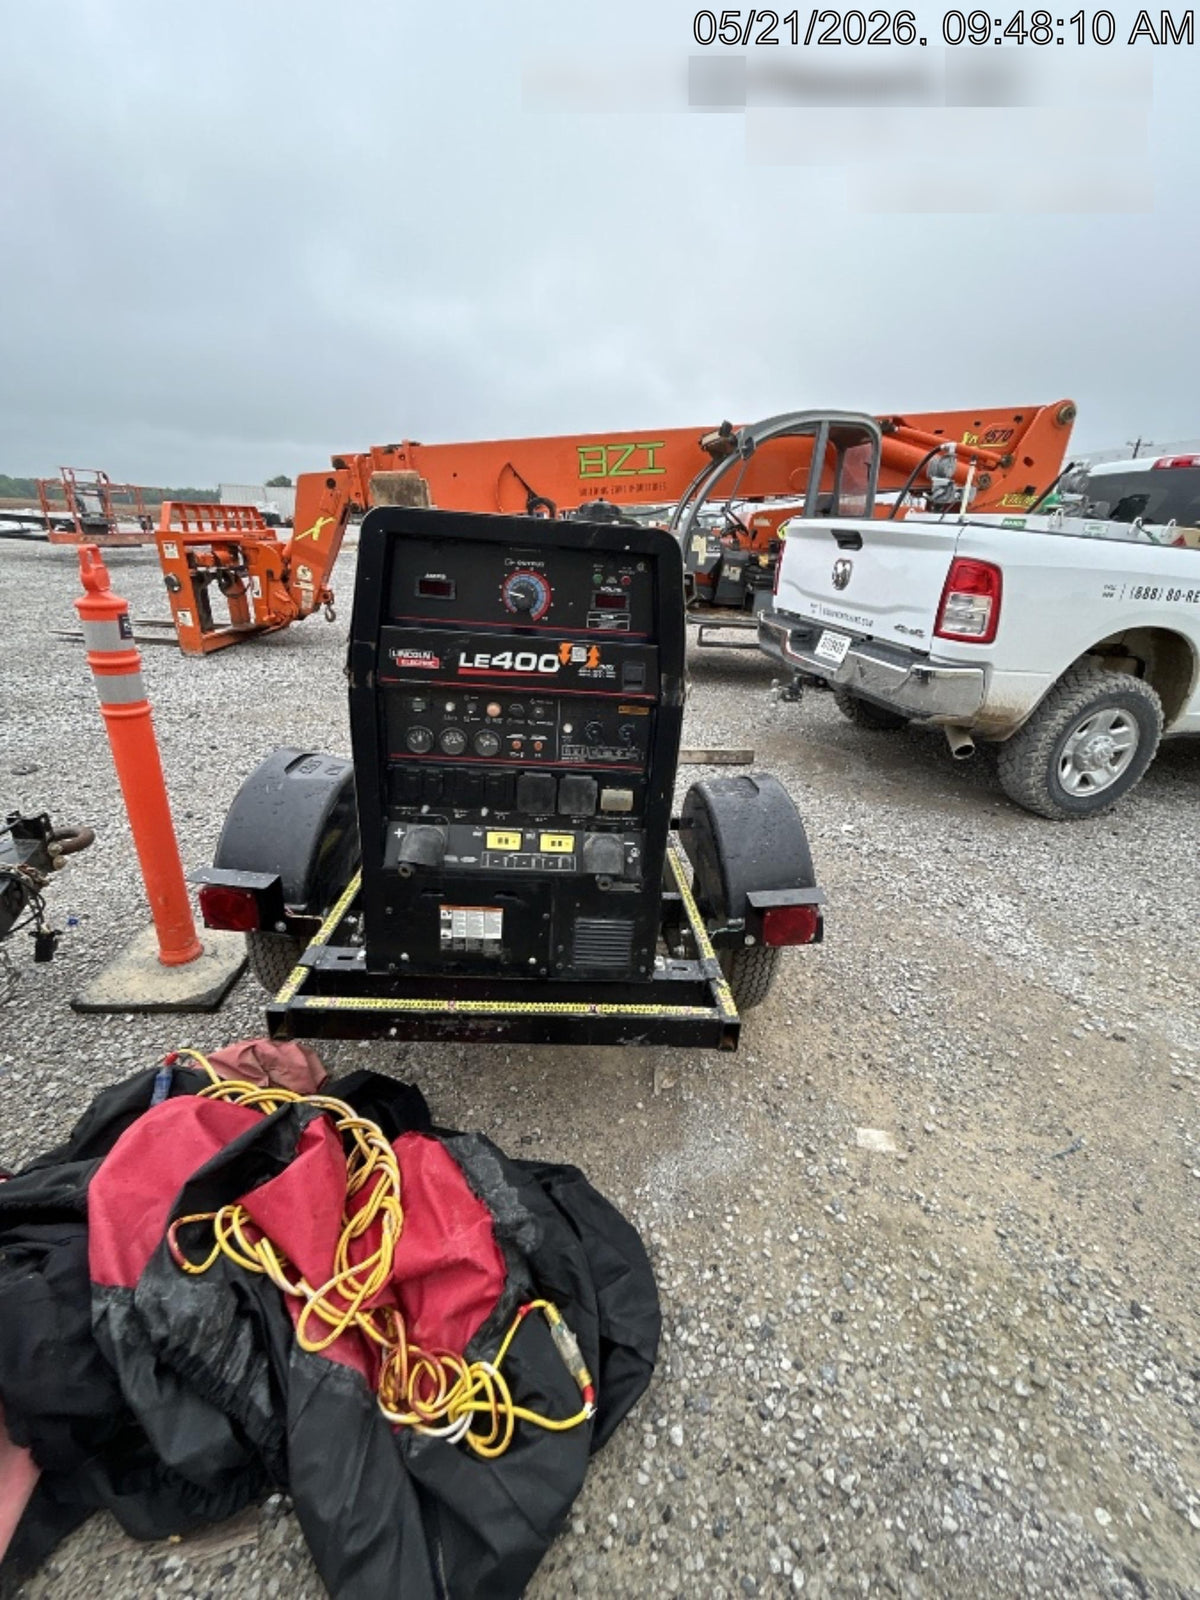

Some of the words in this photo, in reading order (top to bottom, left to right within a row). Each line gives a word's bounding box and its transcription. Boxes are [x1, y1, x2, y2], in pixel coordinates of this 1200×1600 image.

[576, 441, 667, 479] BZI
[391, 649, 432, 659] LINCOLN
[458, 651, 561, 673] LE400
